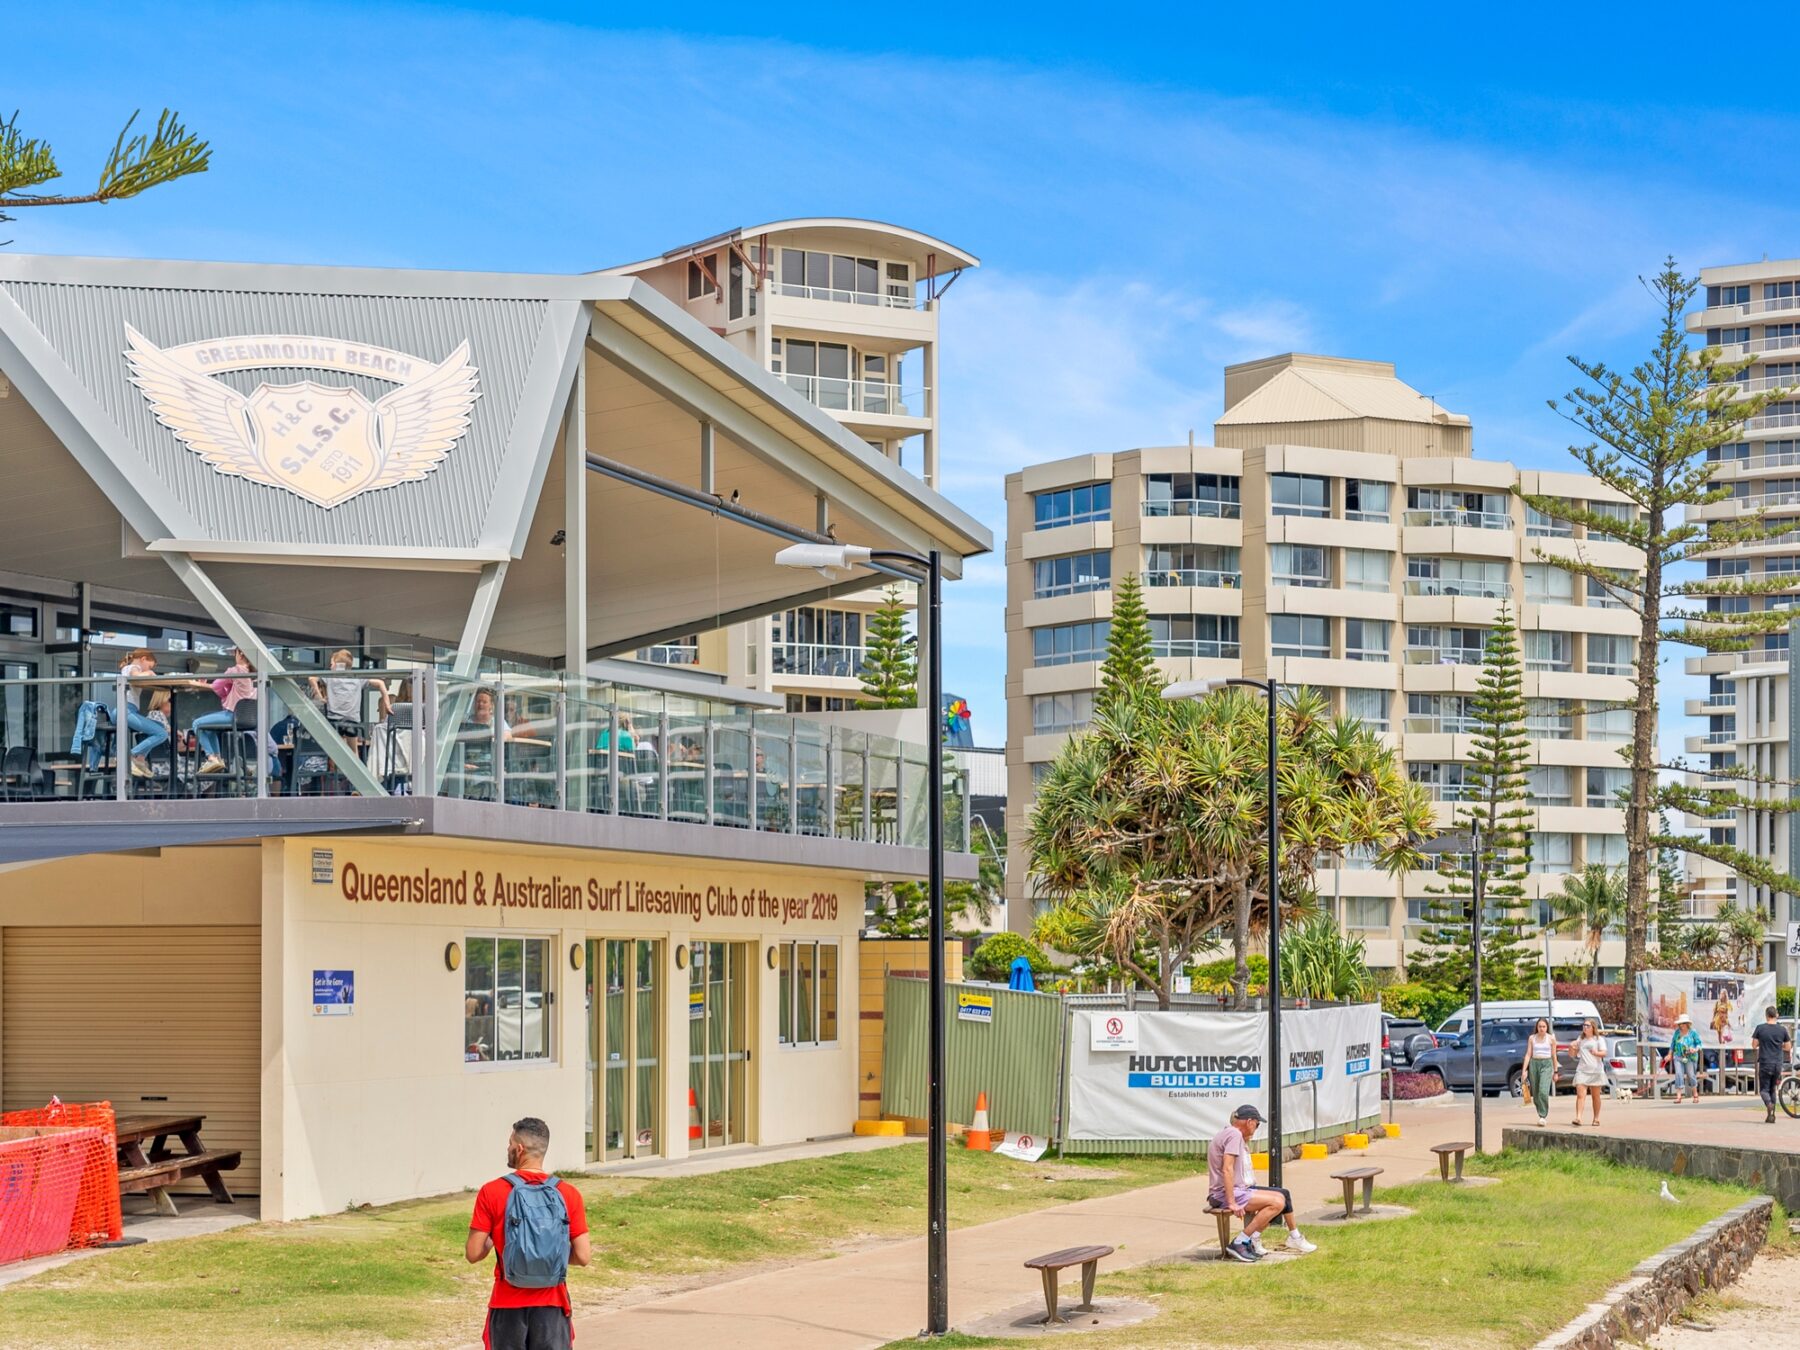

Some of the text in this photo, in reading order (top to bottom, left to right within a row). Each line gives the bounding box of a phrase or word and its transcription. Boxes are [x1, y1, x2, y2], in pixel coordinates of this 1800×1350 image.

[195, 343, 412, 376] GREENMOUNT BEACH
[331, 456, 363, 484] 1911
[341, 861, 838, 925] Queensland & Australian Surf Lifesaving Club of the year 2019
[1129, 1055, 1261, 1073] HUTCHINSON
[1150, 1075, 1246, 1087] BUILDERS
[1168, 1090, 1228, 1098] Established 1912
